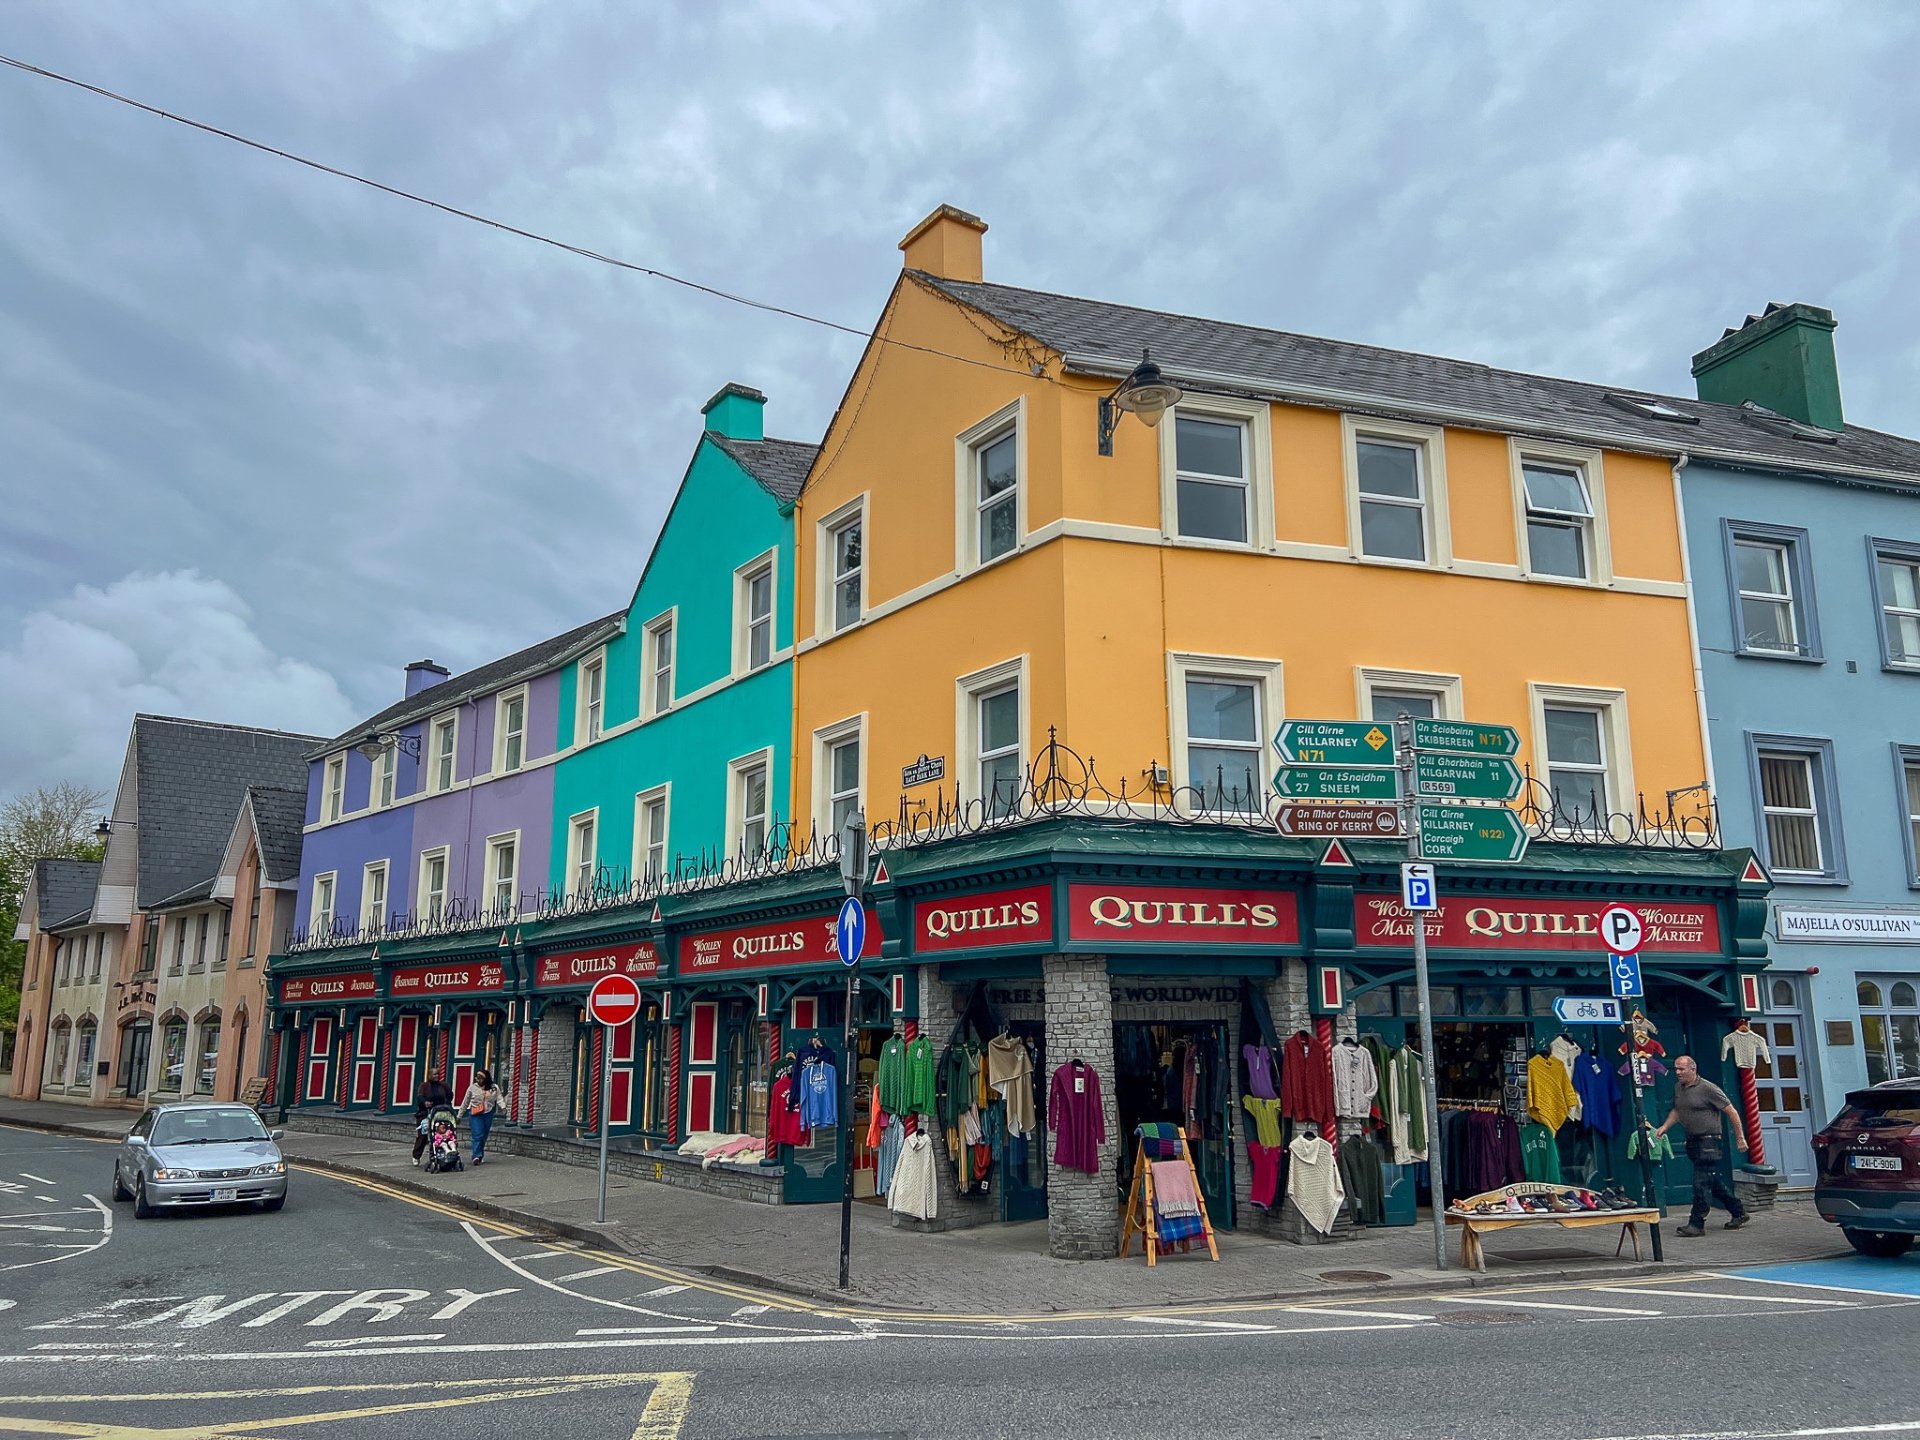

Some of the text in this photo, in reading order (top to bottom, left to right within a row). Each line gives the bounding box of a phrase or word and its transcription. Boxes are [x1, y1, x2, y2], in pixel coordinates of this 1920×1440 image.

[1296, 725, 1344, 735] Cill Airne
[1417, 723, 1429, 732] An
[1297, 737, 1358, 747] KILLARNEY
[1418, 734, 1474, 748] SKIBBEREEN
[1479, 733, 1502, 746] N71
[1299, 749, 1325, 762] N71
[1419, 756, 1435, 765] Cill
[1489, 760, 1500, 768] km
[1319, 772, 1386, 782] An tSnaidhm
[1420, 768, 1476, 780] KILGARVAN
[1490, 772, 1500, 781] 11
[1295, 783, 1310, 792] 27
[1320, 784, 1360, 793] SNEEM
[1297, 809, 1310, 818] An
[1338, 809, 1373, 819] Chuaird
[1422, 808, 1465, 819] Cill Airne
[1298, 821, 1374, 831] RING OF KERRY
[1423, 820, 1474, 831] KILLARNEY
[1424, 833, 1464, 845] Corcaigh
[1425, 845, 1454, 855] CORK
[1412, 881, 1427, 903] P
[1089, 895, 1279, 929] QUILL'S
[1637, 908, 1705, 925] WOOLLEN
[926, 900, 1040, 939] QUILL'S
[1787, 917, 1840, 932] MAJELLA
[1842, 918, 1911, 932] O'SULLIVAN
[1611, 912, 1631, 945] P
[1644, 925, 1704, 943] MARKET
[693, 938, 722, 953] WOOLLEN
[732, 931, 805, 959] QUILL'S
[570, 955, 617, 977] QUILL'S
[692, 952, 720, 967] MARKET
[424, 971, 469, 988] QUILL'S
[1621, 981, 1634, 995] P
[991, 989, 1031, 1004] FREE
